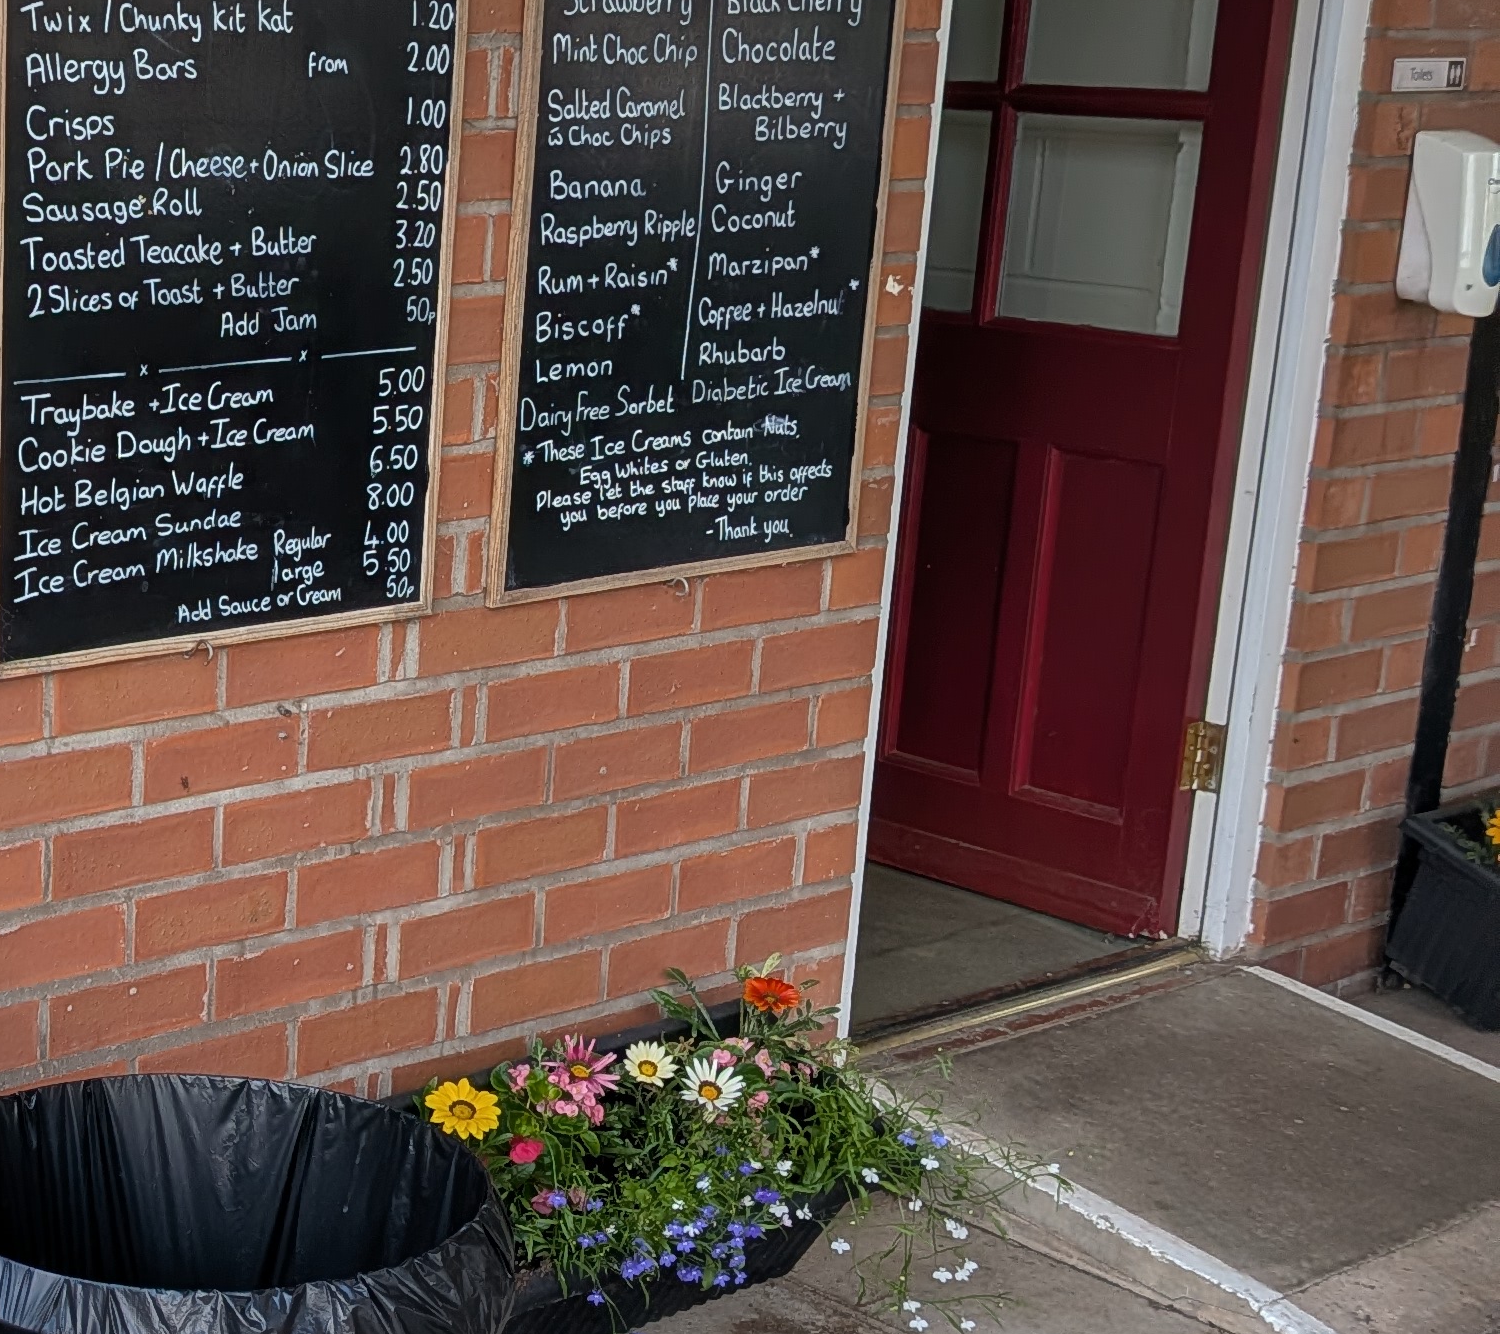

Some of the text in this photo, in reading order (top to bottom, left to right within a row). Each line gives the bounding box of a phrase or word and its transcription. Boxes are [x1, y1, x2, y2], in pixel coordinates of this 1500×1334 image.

[722, 25, 836, 64] Chocolate
[25, 41, 450, 95] Allergy Bars from 2.00
[26, 96, 446, 141] Crisps 1.00
[22, 179, 442, 225] Sausage Roll 2.50
[549, 169, 647, 200] Banana
[715, 160, 803, 203] Ginger
[711, 199, 796, 233] Coconut
[535, 359, 613, 384] Lemon
[698, 336, 786, 366] Rhubarb
[20, 444, 419, 516] Hot Belgian Waffle 6.50
[560, 483, 809, 532] you before you place your order
